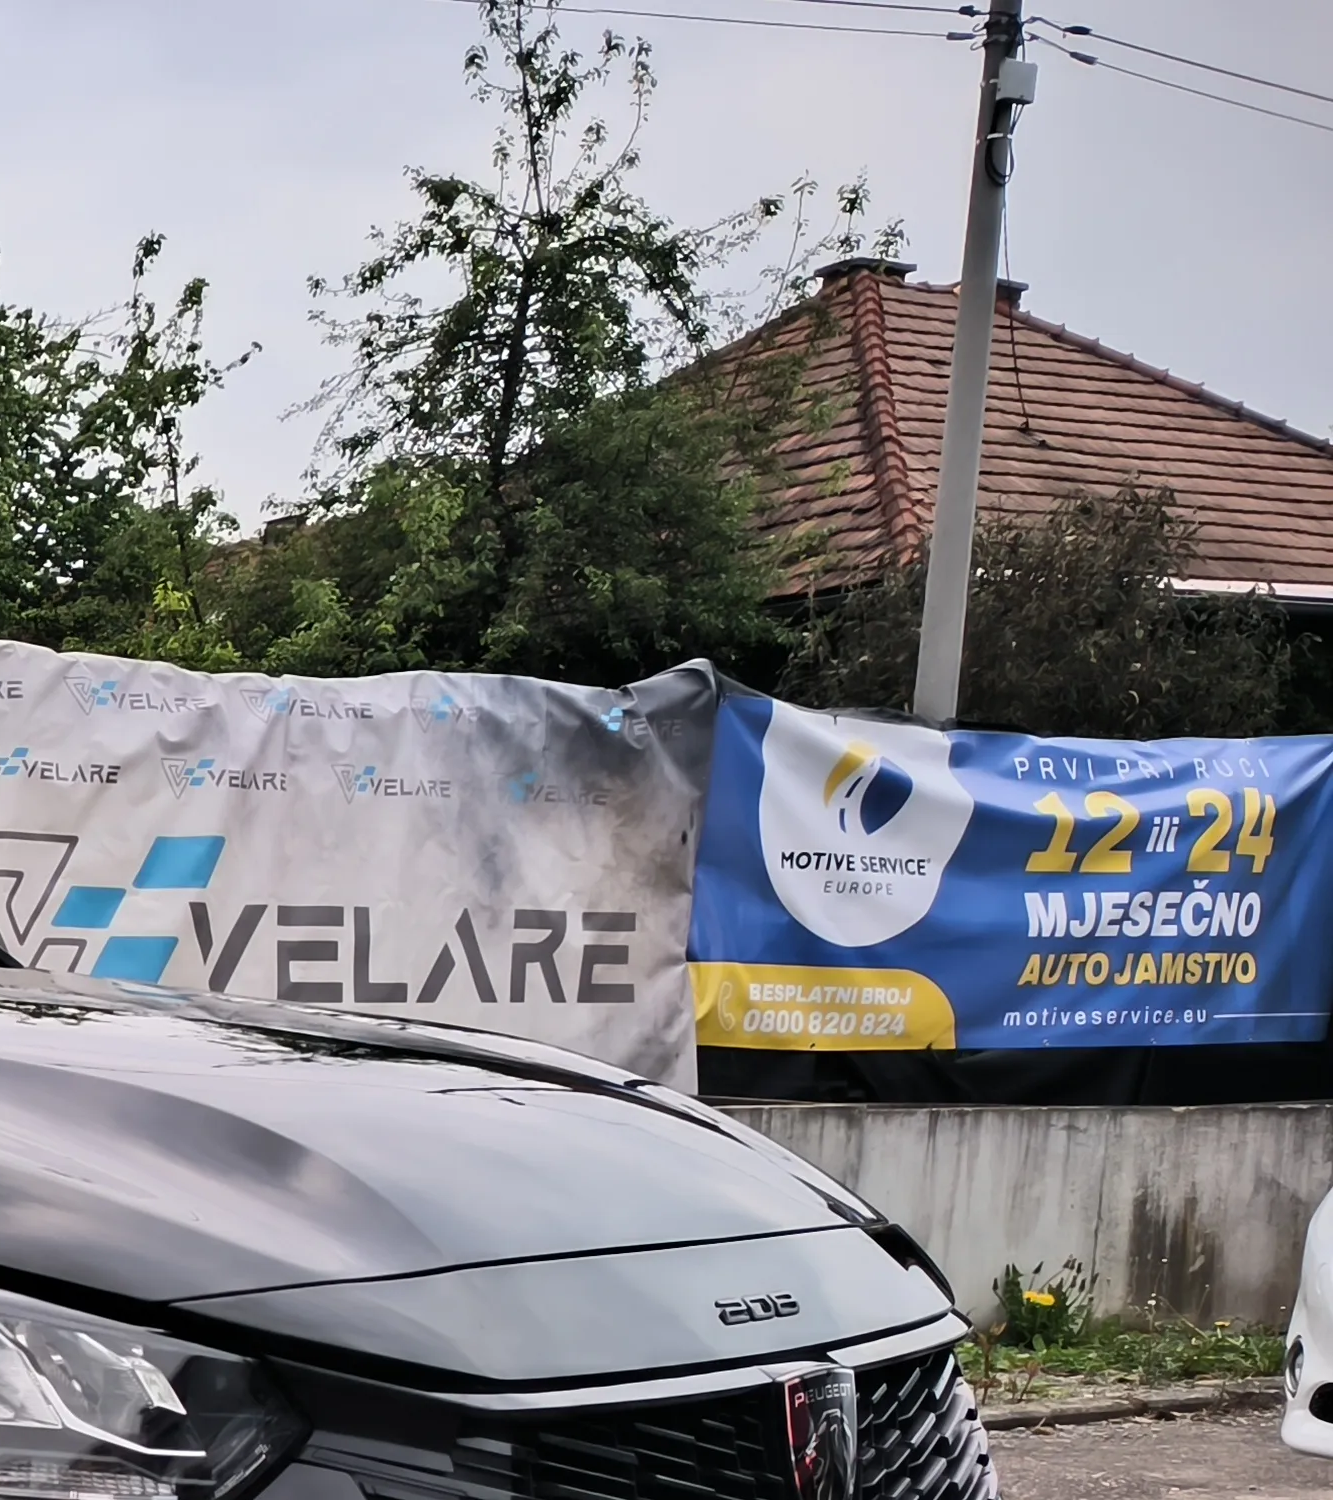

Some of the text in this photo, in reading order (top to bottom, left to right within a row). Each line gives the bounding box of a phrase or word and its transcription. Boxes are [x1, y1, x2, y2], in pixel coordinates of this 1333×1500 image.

[110, 692, 208, 713] VELARE
[22, 760, 121, 784] VELARE
[207, 769, 287, 791] VELARE
[1013, 757, 1270, 780] PRVI PRI RUCI
[369, 778, 452, 798] VELARE
[1025, 787, 1276, 873] 12 ili 24
[781, 852, 856, 872] MOTIVE
[823, 880, 893, 896] EUROPE
[1024, 879, 1261, 938] MJESEČNO
[188, 902, 636, 1004] VELARE
[1017, 952, 1257, 986] AUTO JAMSTVO
[749, 983, 912, 1005] BESPLATNI BROJ
[743, 1009, 907, 1036] 0800 820 824
[1003, 1006, 1207, 1027] motiveservice.eu
[714, 1291, 800, 1326] 208
[794, 1383, 851, 1408] PEUGEOT
